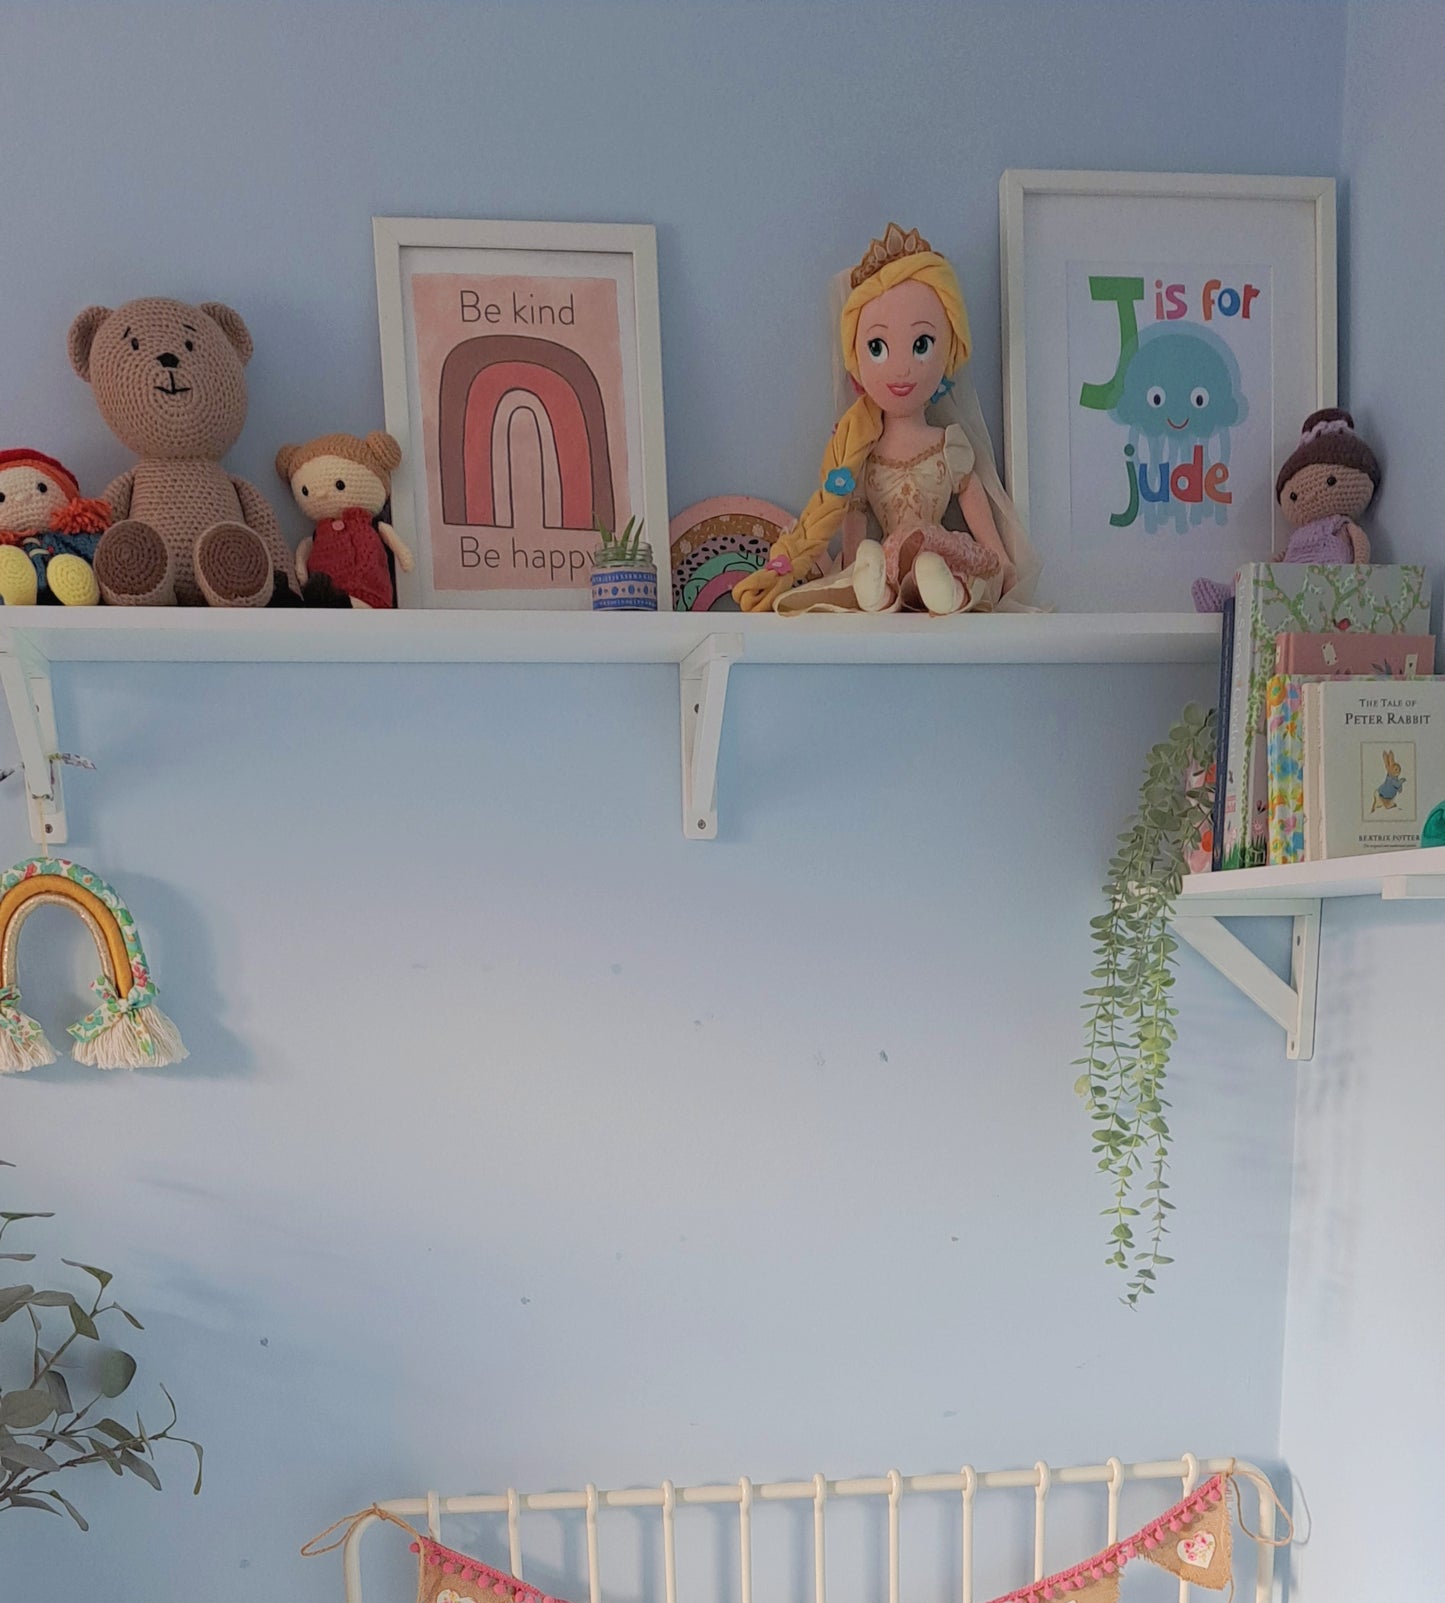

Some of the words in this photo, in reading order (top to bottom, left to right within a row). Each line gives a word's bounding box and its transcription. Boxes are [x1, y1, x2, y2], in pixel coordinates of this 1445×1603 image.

[460, 290, 501, 323] Be
[513, 291, 575, 326] kind
[1079, 276, 1145, 411] J
[1155, 280, 1188, 320] is
[1202, 279, 1260, 321] for
[1110, 444, 1232, 527] jude
[460, 536, 500, 568] Be
[1345, 712, 1383, 725] PETER
[1386, 712, 1431, 725] RABBIT
